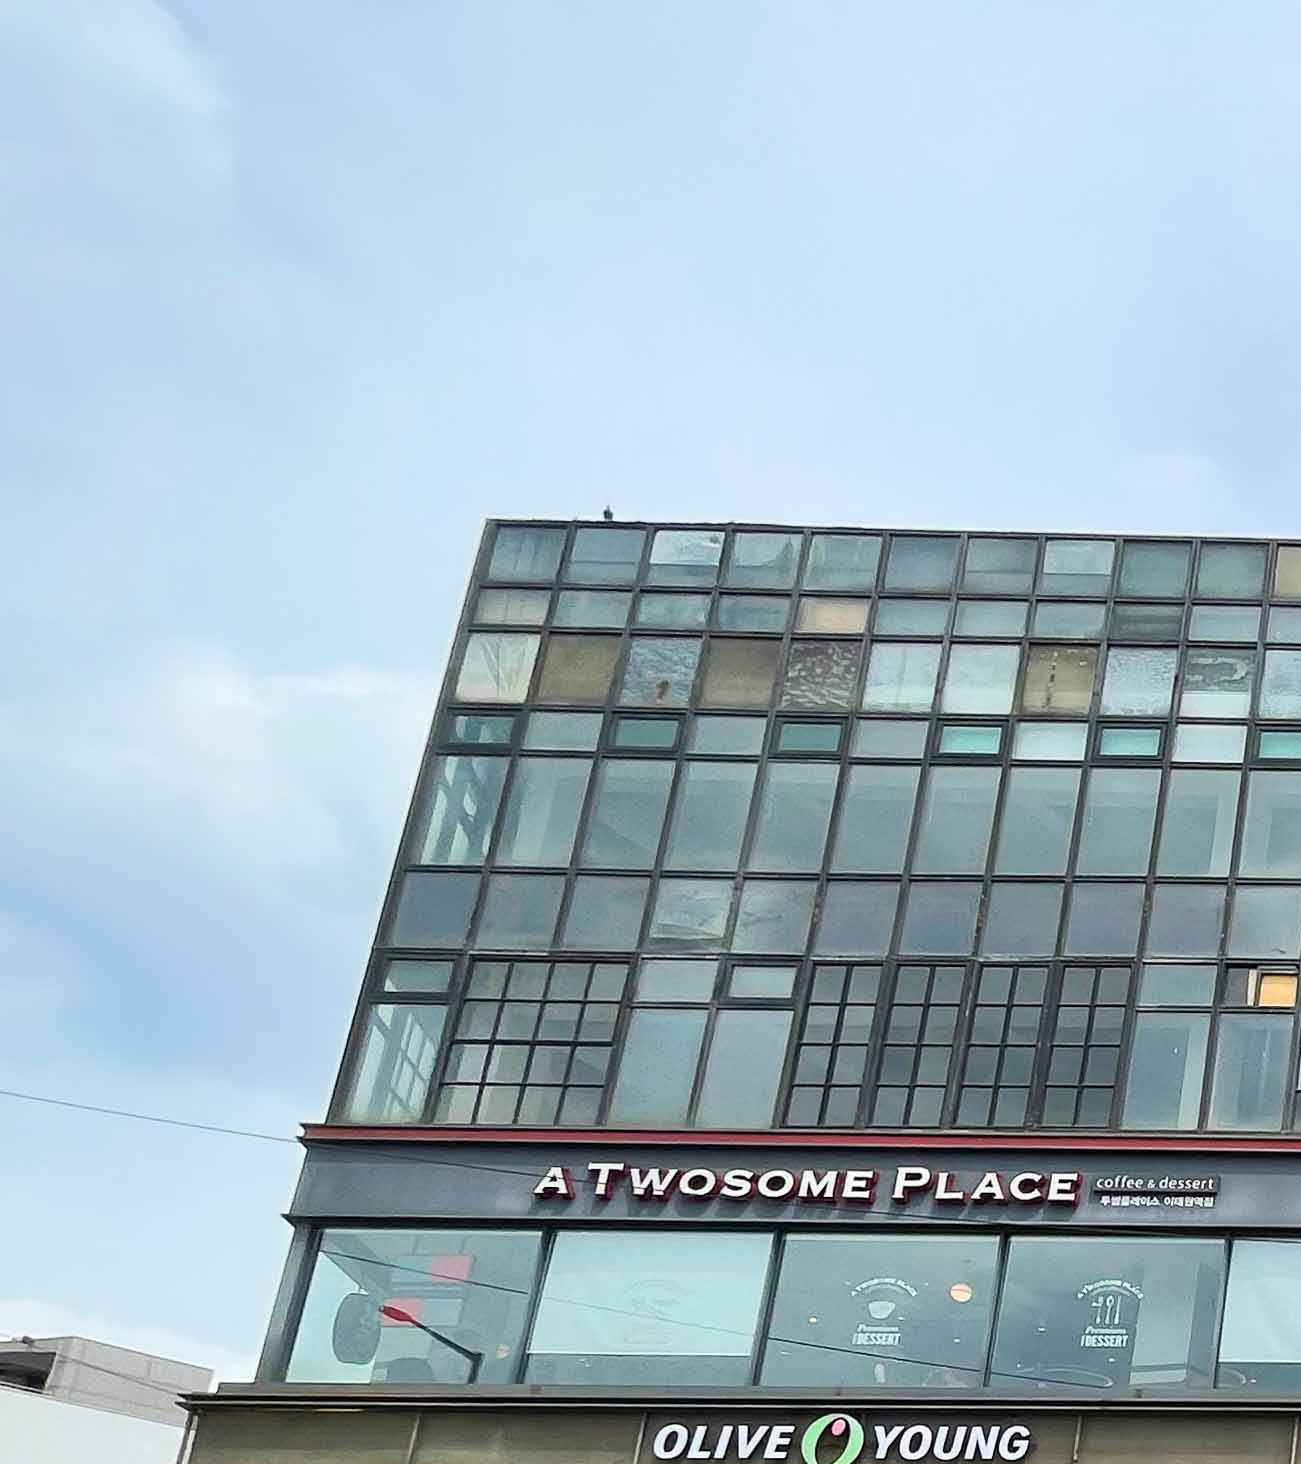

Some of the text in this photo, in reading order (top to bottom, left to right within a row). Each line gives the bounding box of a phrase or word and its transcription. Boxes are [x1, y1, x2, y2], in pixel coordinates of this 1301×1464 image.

[533, 1166, 569, 1196] A
[1096, 1175, 1214, 1189] coffee & dessert
[653, 1423, 796, 1460] OLIVE
[873, 1424, 1031, 1461] YOUNG
